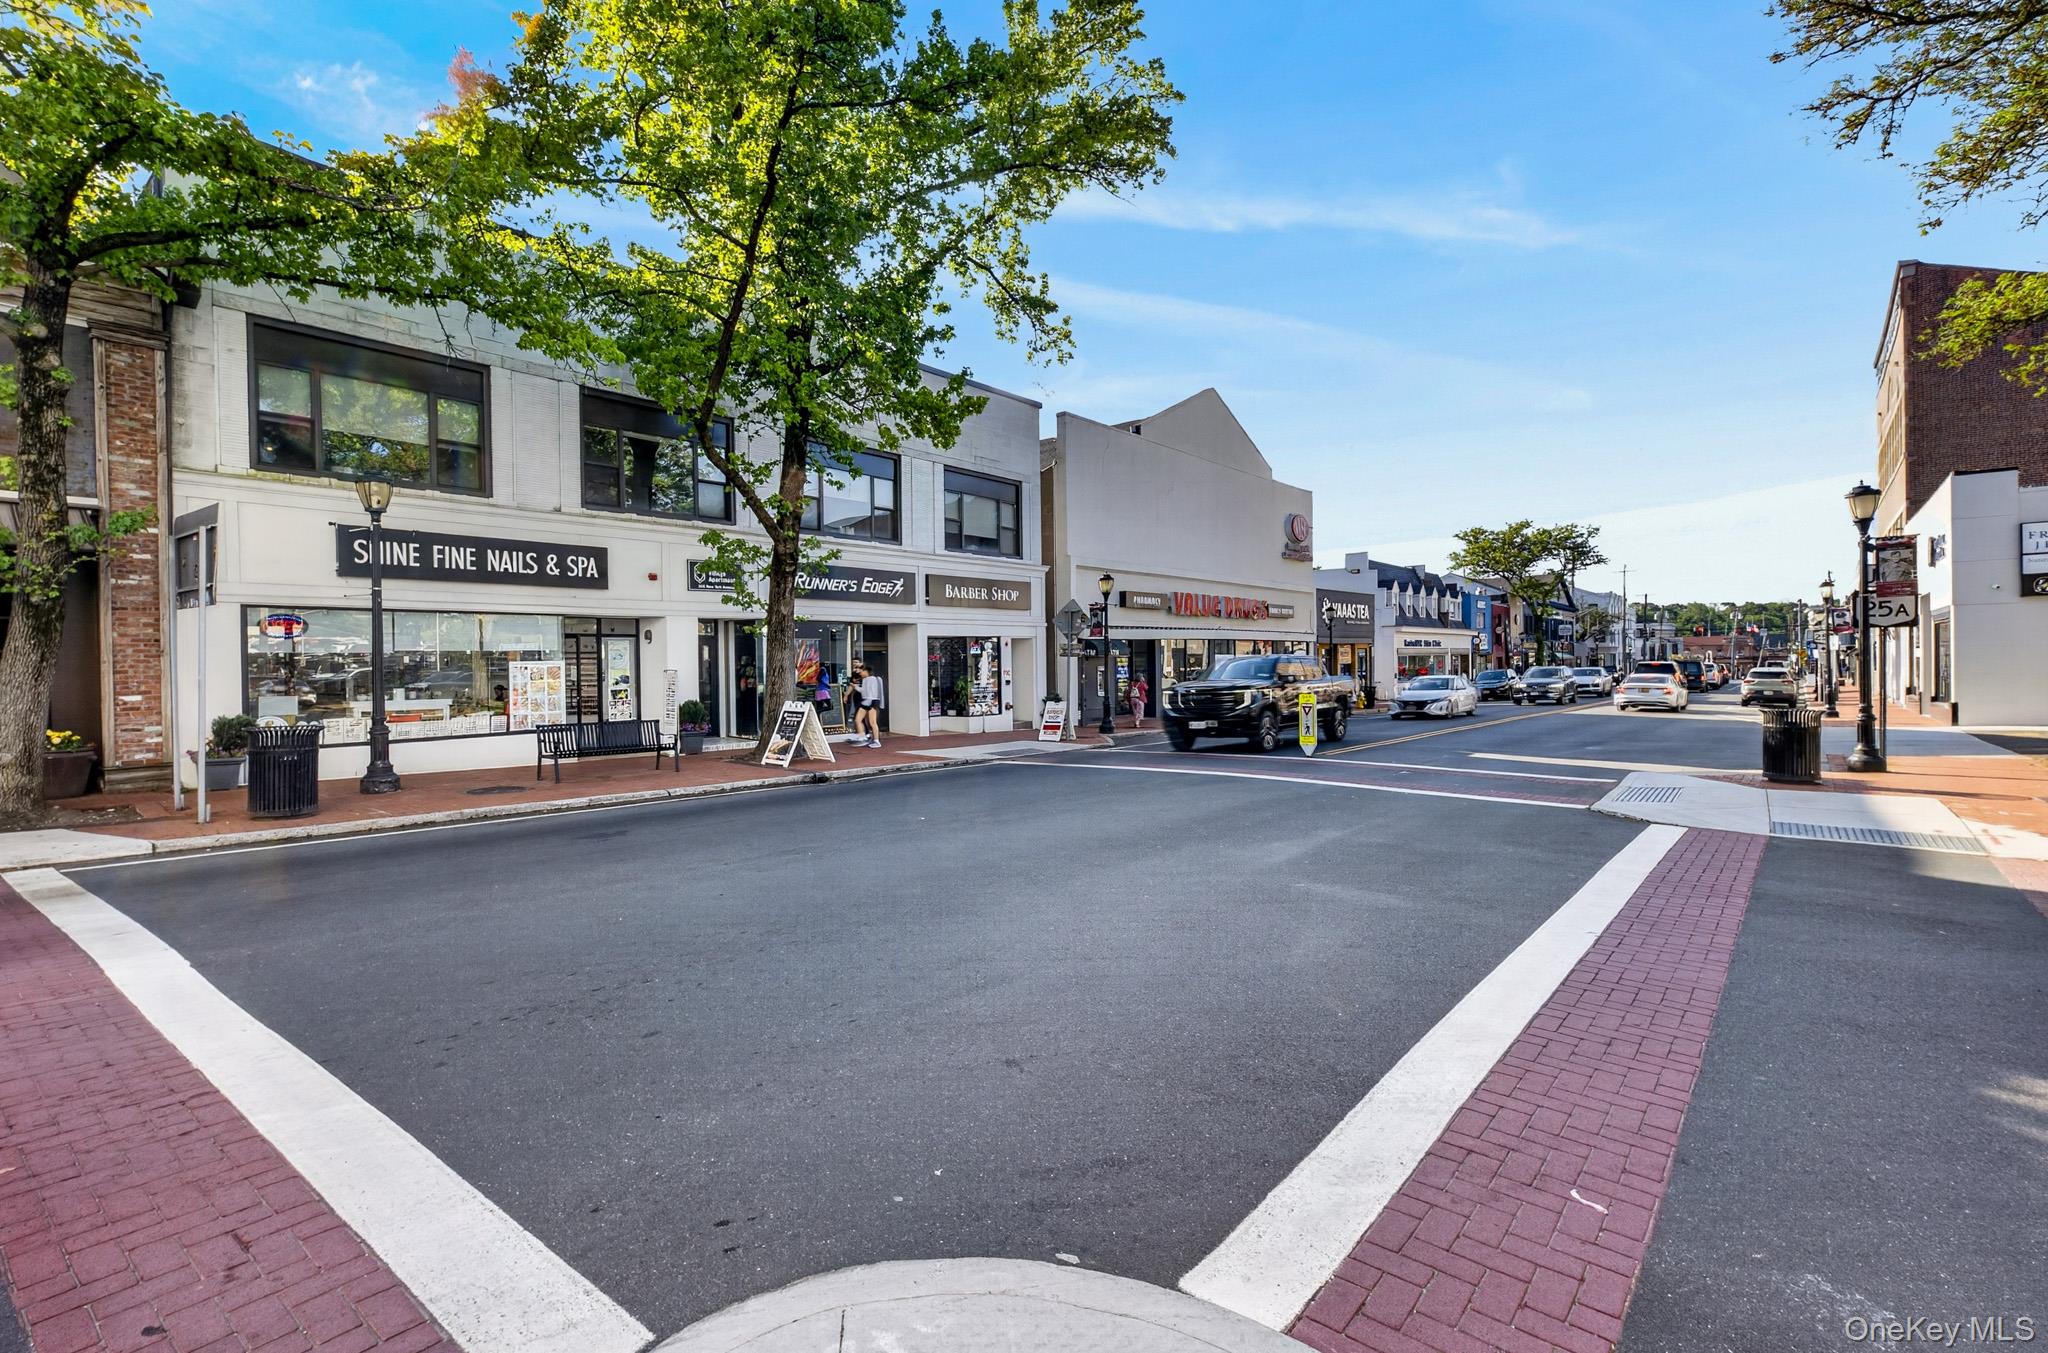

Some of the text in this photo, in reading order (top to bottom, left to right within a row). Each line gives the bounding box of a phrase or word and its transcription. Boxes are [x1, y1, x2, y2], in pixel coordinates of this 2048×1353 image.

[432, 544, 477, 571] FINE
[487, 549, 538, 575] NAILS
[546, 553, 561, 576] &
[567, 555, 599, 578] SPA
[794, 572, 894, 594] RUNNER'S EDGE
[945, 583, 1019, 602] BARBER SHOP
[1172, 591, 1268, 620] VALUE DRUGS
[1357, 604, 1370, 620] TEA
